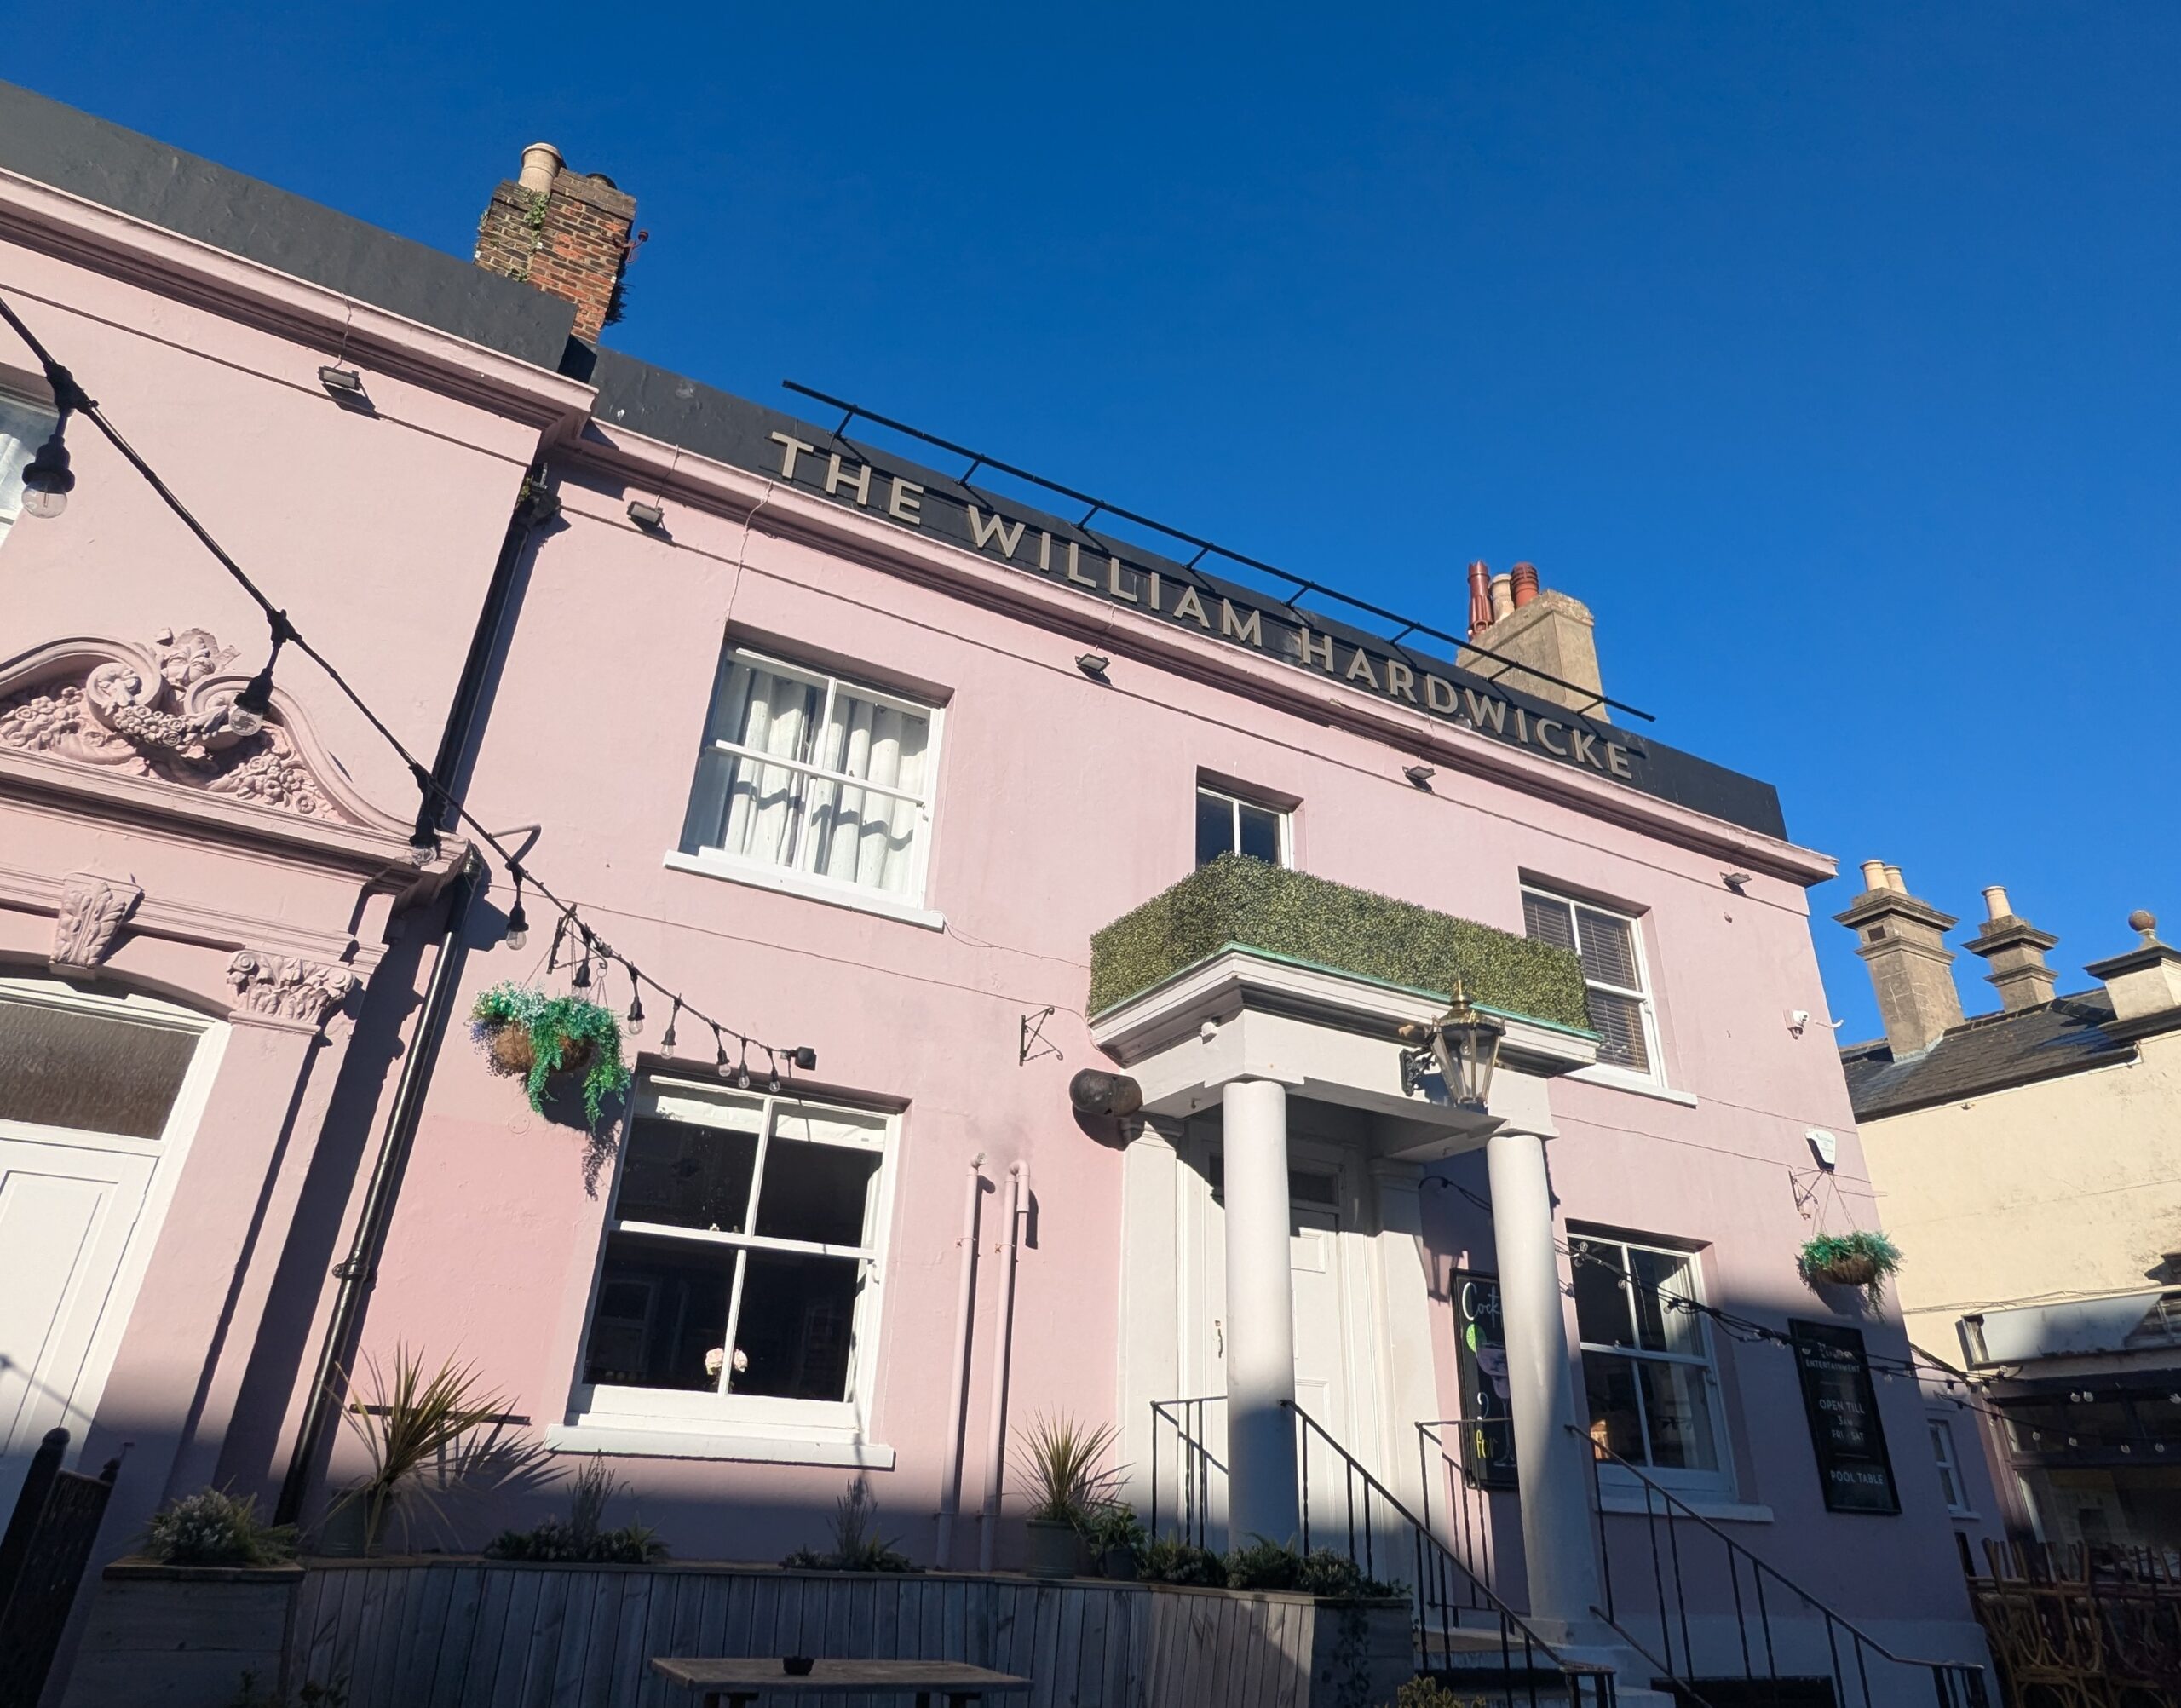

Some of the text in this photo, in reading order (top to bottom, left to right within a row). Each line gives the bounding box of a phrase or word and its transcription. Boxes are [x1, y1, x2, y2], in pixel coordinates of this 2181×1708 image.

[771, 431, 1633, 780] THE WILLIAM HARDWICKE
[1462, 1281, 1500, 1328] Cock
[1805, 1359, 1861, 1373] ENTERTAINMENT
[1819, 1399, 1866, 1415] OPEN TILL
[1831, 1429, 1865, 1441] FRI SAT
[1476, 1429, 1499, 1459] for
[1830, 1469, 1885, 1486] POOL TABLE
